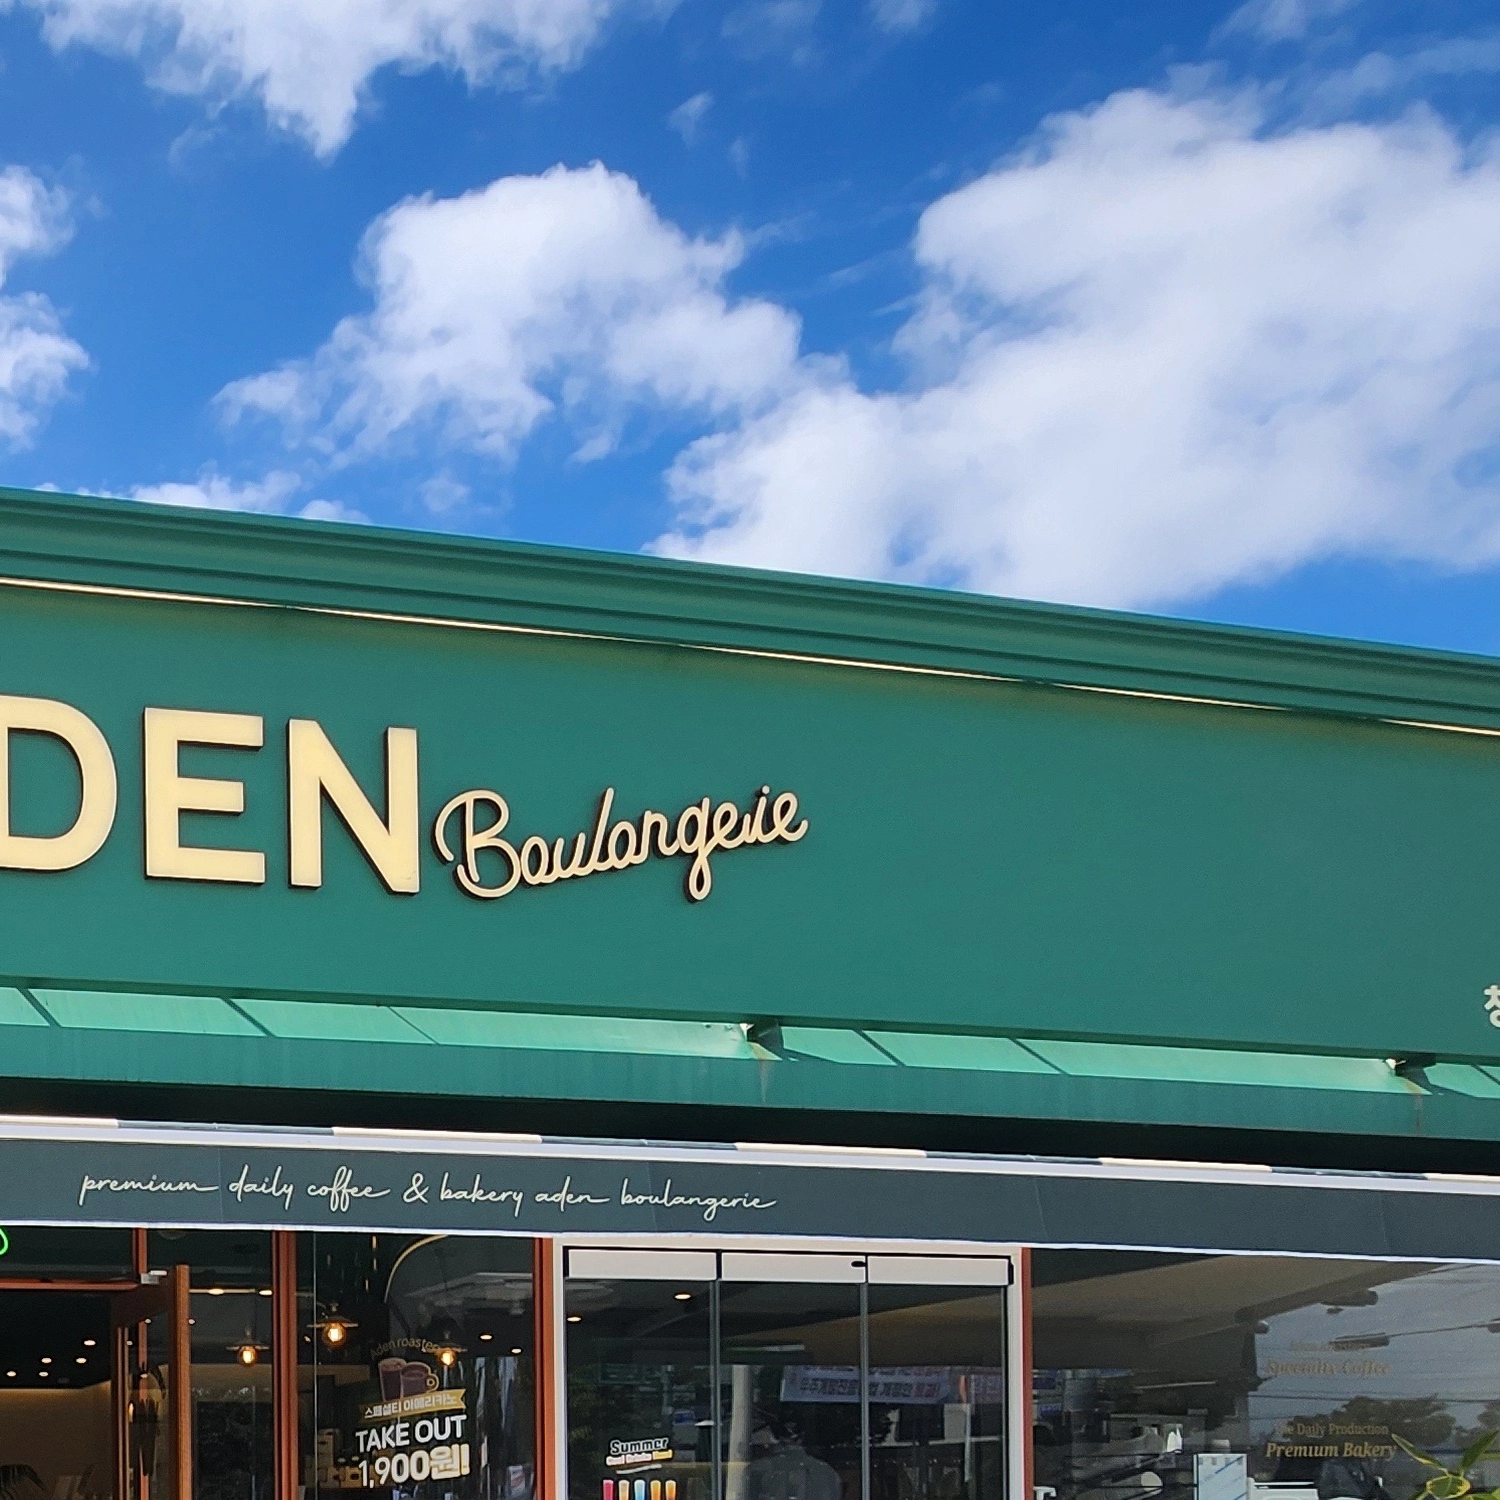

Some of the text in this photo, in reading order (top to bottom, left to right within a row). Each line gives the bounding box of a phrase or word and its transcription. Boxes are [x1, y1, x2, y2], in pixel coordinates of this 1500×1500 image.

[78, 1164, 778, 1222] premium daily coffee & bakery aden boulangerie
[355, 1414, 468, 1453] TAKE OUT
[1297, 1423, 1327, 1436] Daily
[1329, 1422, 1389, 1435] Production
[609, 1437, 669, 1455] Summer
[1265, 1441, 1398, 1462] Premium Bakery
[358, 1443, 471, 1489] 1,900원!
